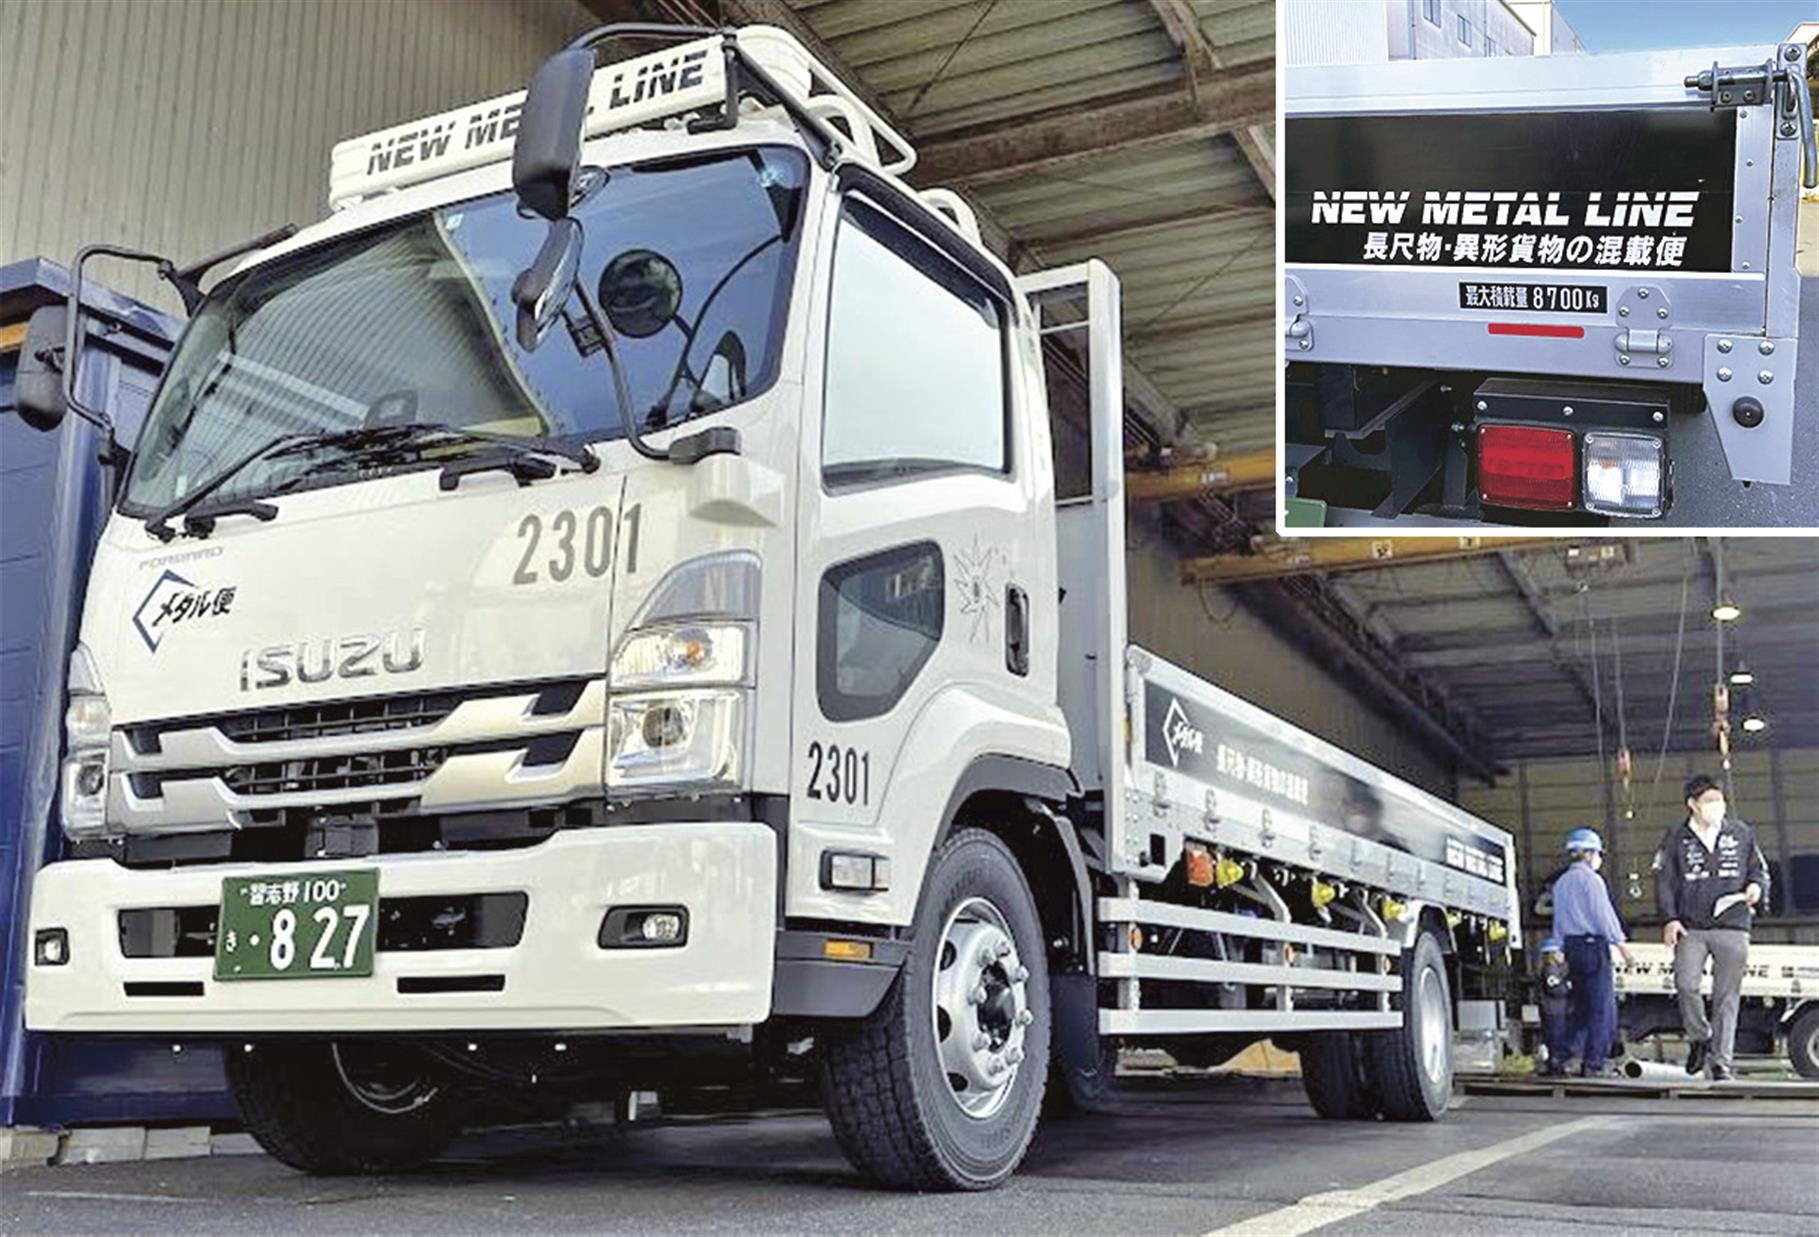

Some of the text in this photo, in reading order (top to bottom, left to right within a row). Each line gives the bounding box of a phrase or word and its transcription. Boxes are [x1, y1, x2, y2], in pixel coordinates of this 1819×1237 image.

[366, 122, 456, 175] NEW
[610, 51, 707, 109] LINE
[1311, 191, 1700, 227] NEW METAL LINE
[1362, 231, 1688, 267] 長尺物・異形貨物の混載便
[512, 502, 643, 586] 2301
[239, 628, 426, 692] ISUZU
[807, 740, 869, 806] 2301
[303, 879, 340, 903] 100
